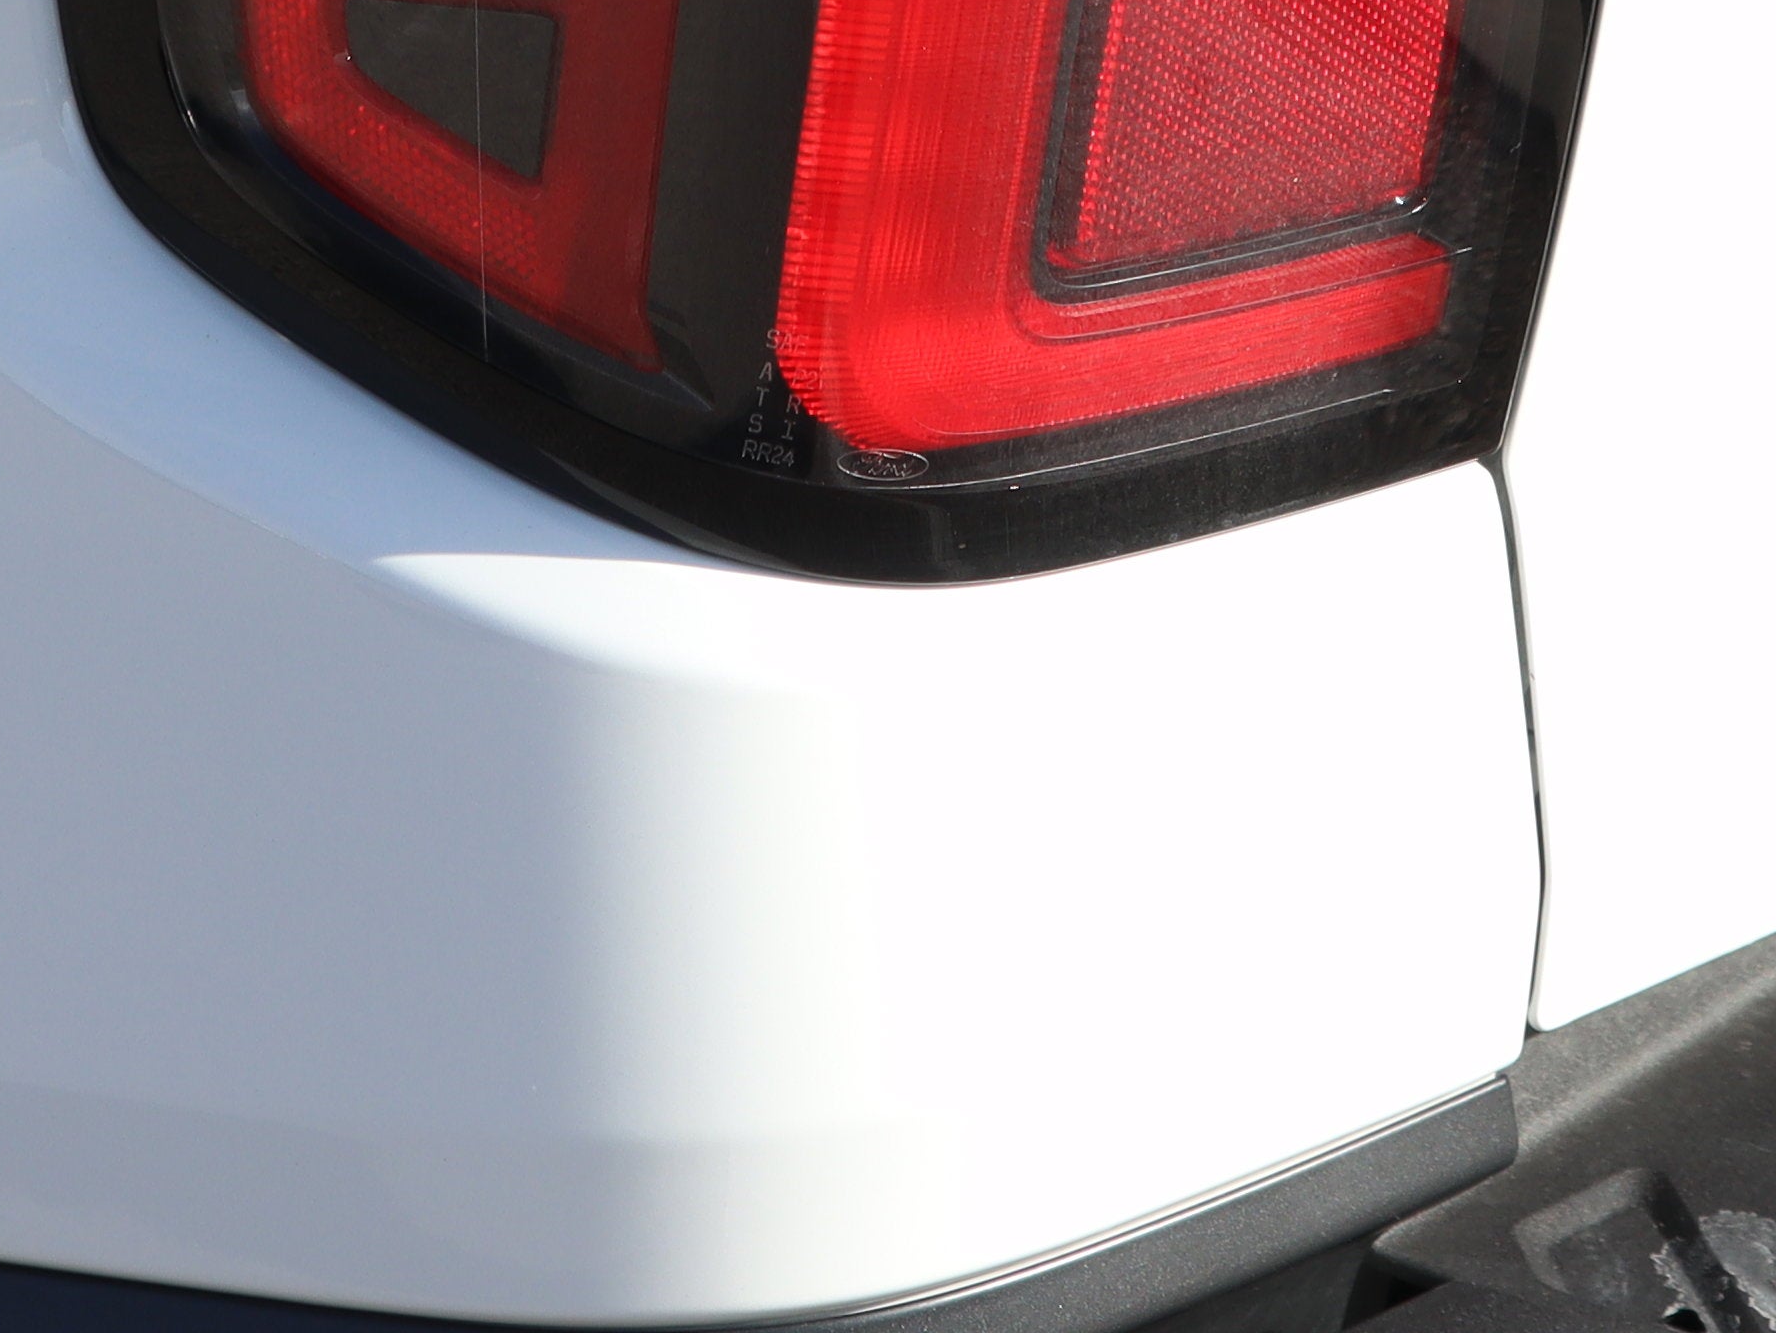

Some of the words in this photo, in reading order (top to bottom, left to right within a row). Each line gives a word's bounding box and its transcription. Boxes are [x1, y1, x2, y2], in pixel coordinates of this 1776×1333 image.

[757, 360, 773, 382] A
[755, 384, 771, 408] T
[785, 393, 801, 416] R
[747, 412, 764, 435] S
[740, 438, 796, 468] RR24
